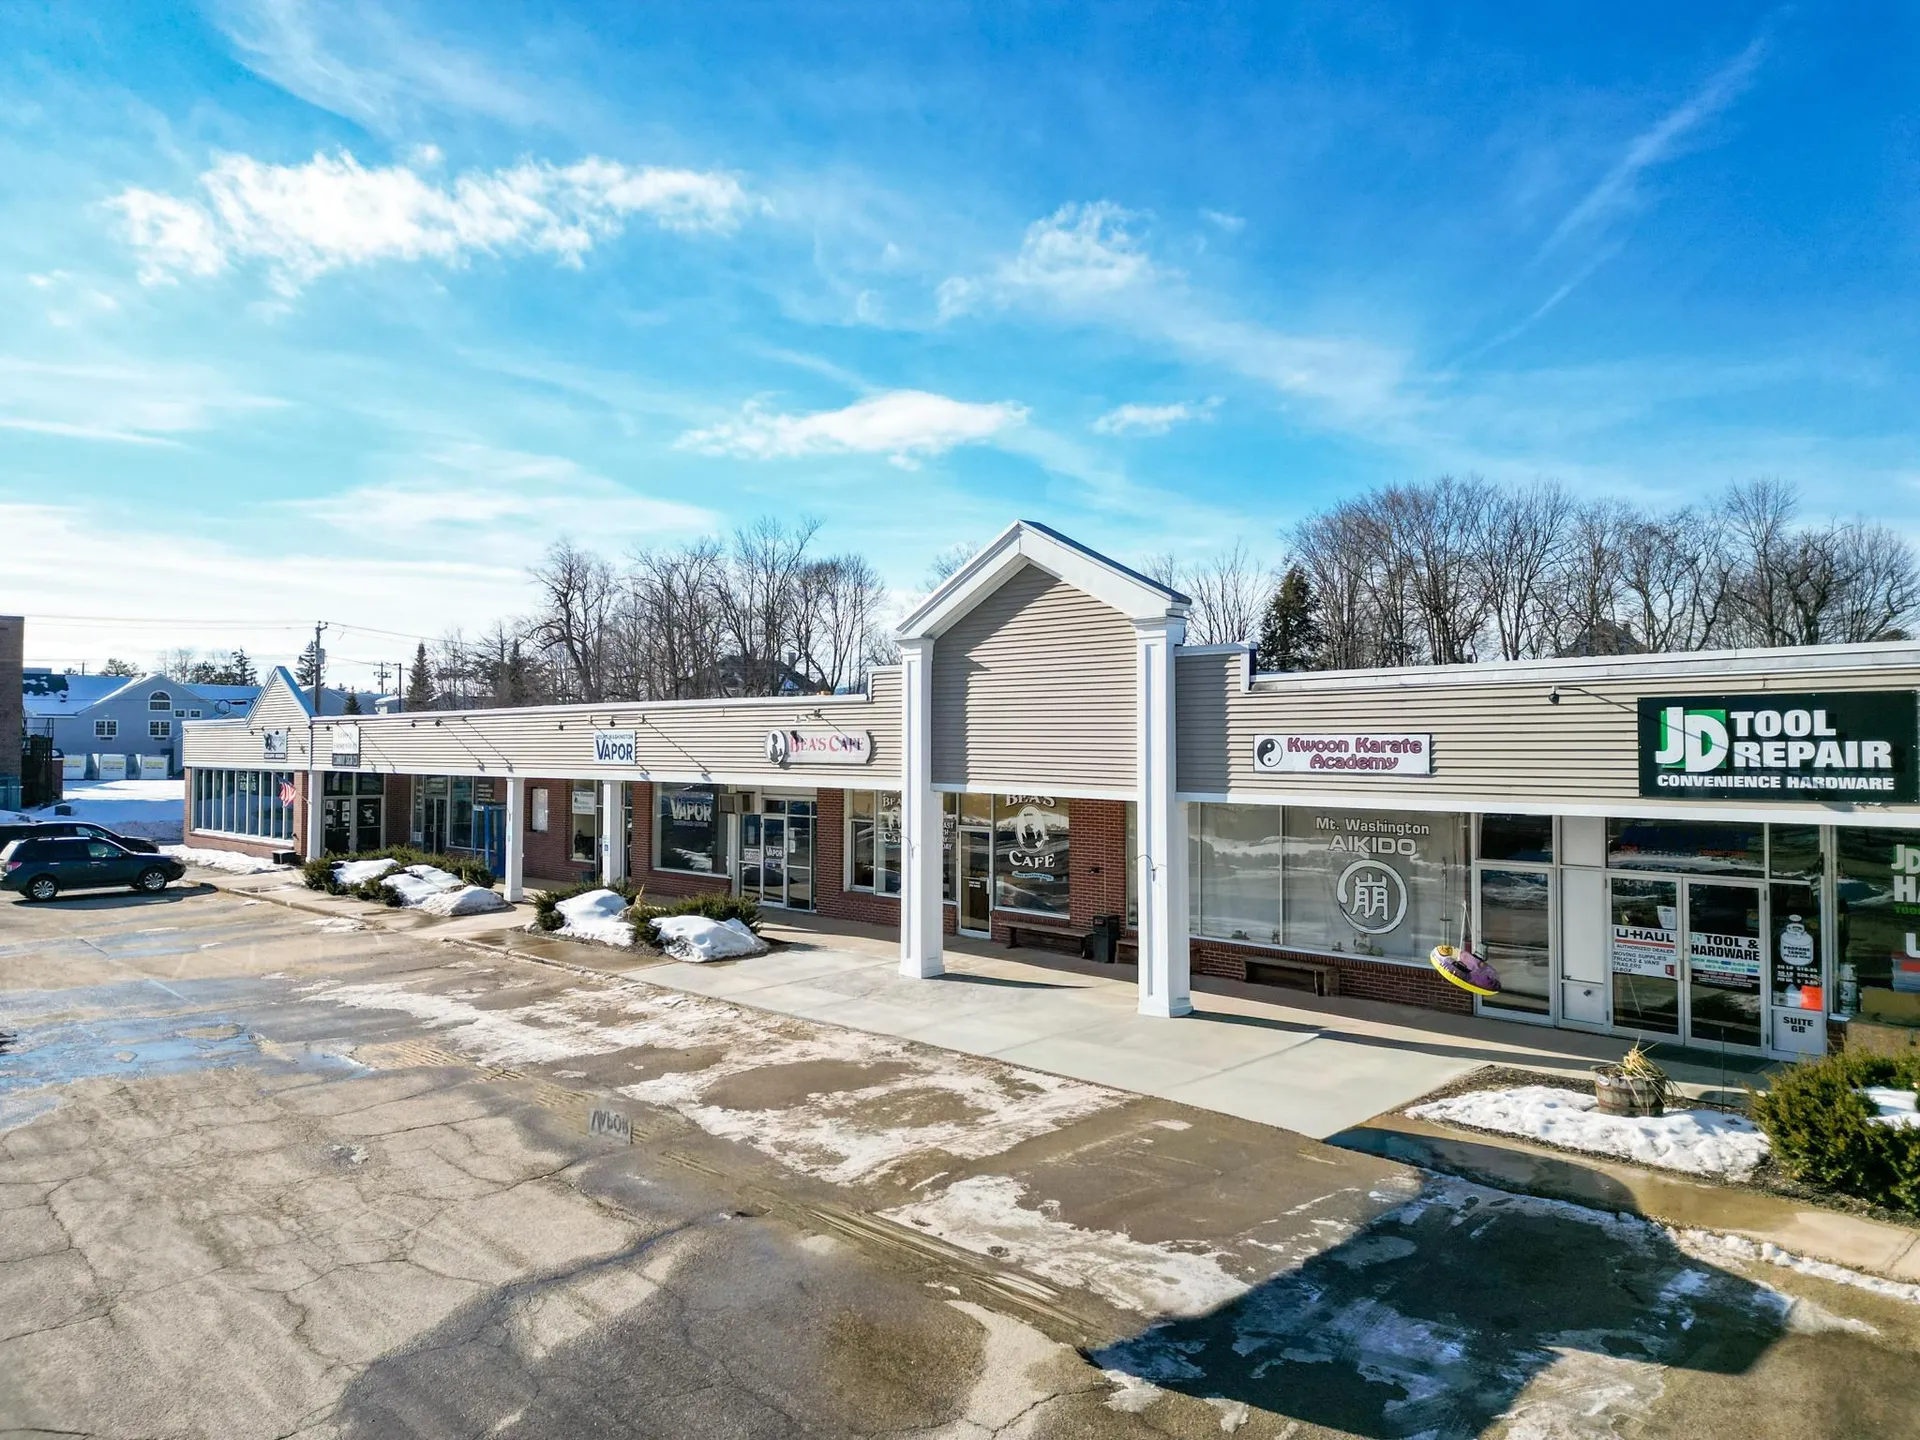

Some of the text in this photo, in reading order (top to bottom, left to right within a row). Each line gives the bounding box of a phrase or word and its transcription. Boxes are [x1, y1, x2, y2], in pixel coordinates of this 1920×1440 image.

[1730, 709, 1836, 737] TOOL
[1287, 737, 1423, 754] Kwoon Karate
[1655, 706, 1729, 773] JD
[596, 739, 633, 761] VAPOR
[1733, 740, 1892, 768] REPAIR
[1309, 754, 1399, 770] Academy
[1657, 774, 1895, 791] CONVENIENCE HARDWARE
[670, 797, 712, 821] VAPOR
[1315, 817, 1430, 836] Mt. Washington
[766, 846, 783, 857] VAPOR
[1328, 834, 1417, 856] AIKIDO
[1616, 928, 1674, 943] U-HAUL
[1705, 935, 1742, 948] TOOL
[1747, 939, 1759, 949] &
[1691, 944, 1760, 961] HARDWARE
[1783, 1016, 1814, 1027] SUITE
